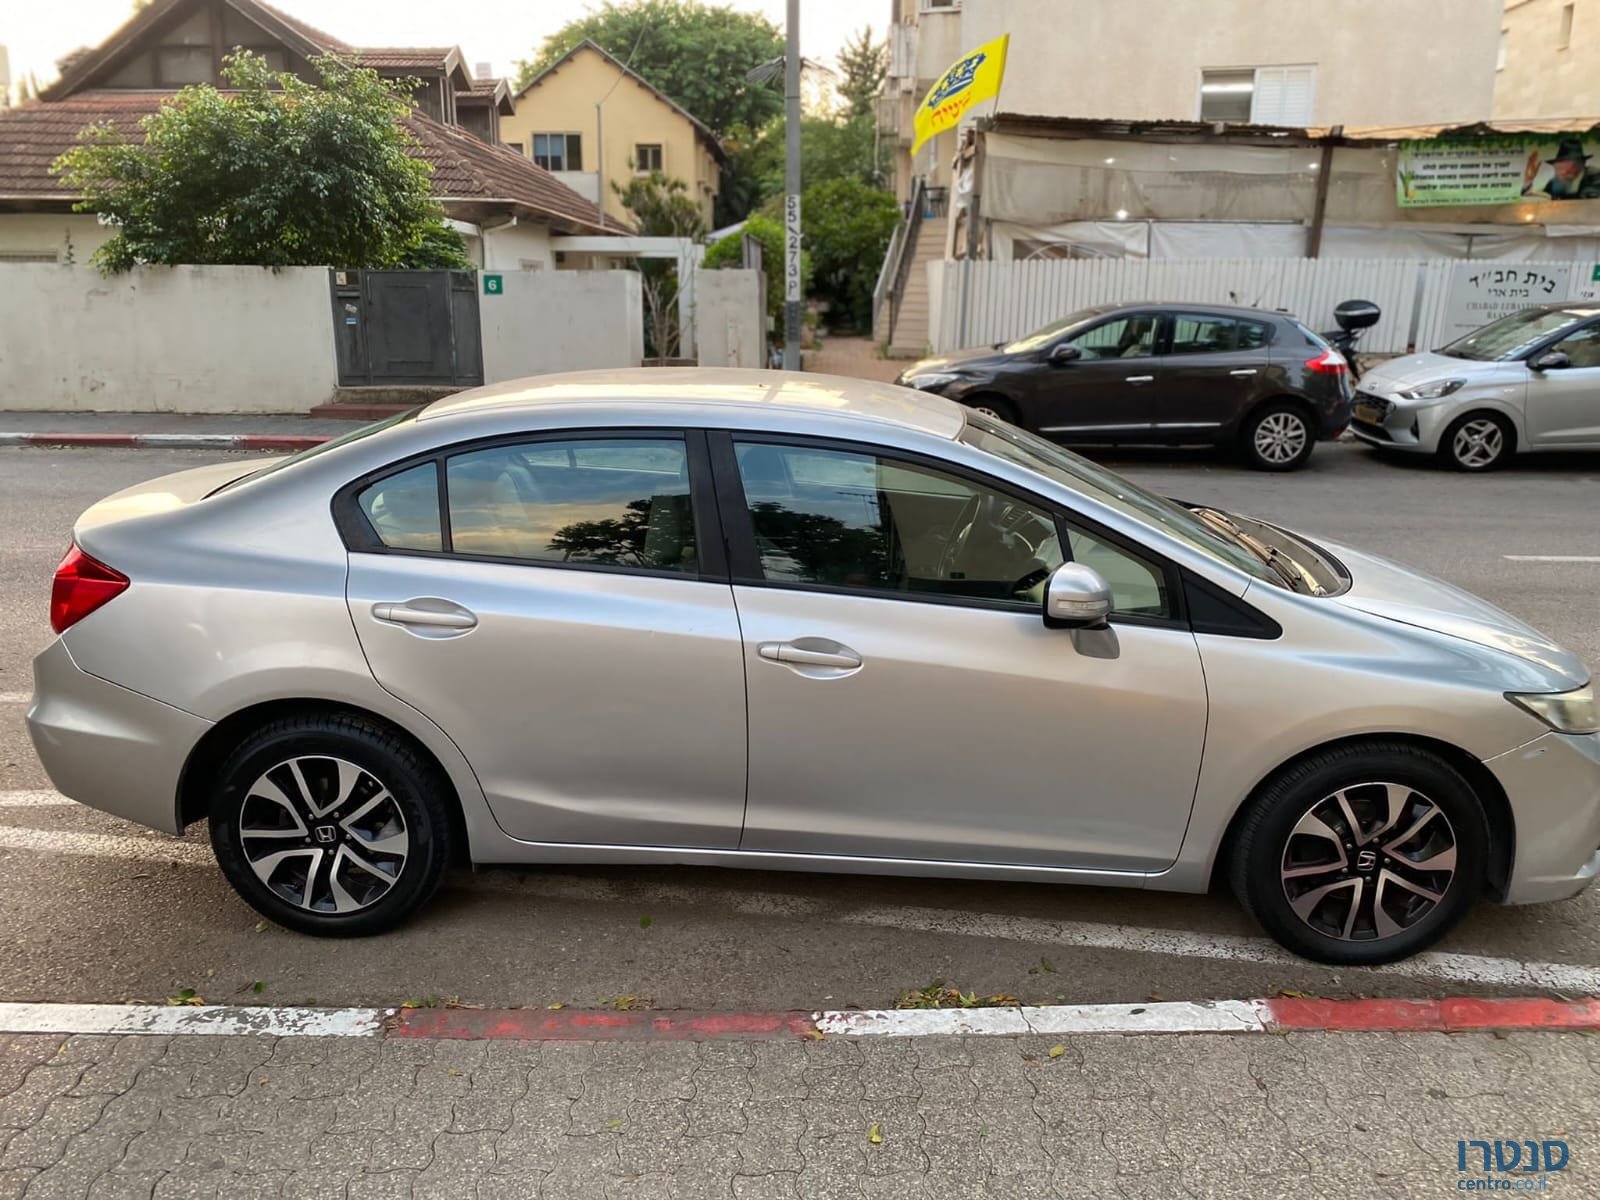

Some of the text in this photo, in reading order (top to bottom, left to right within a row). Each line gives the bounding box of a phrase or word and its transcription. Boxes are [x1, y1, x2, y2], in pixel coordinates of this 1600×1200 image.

[488, 279, 497, 291] 6
[1523, 271, 1556, 294] בית
[1509, 288, 1529, 298] בית
